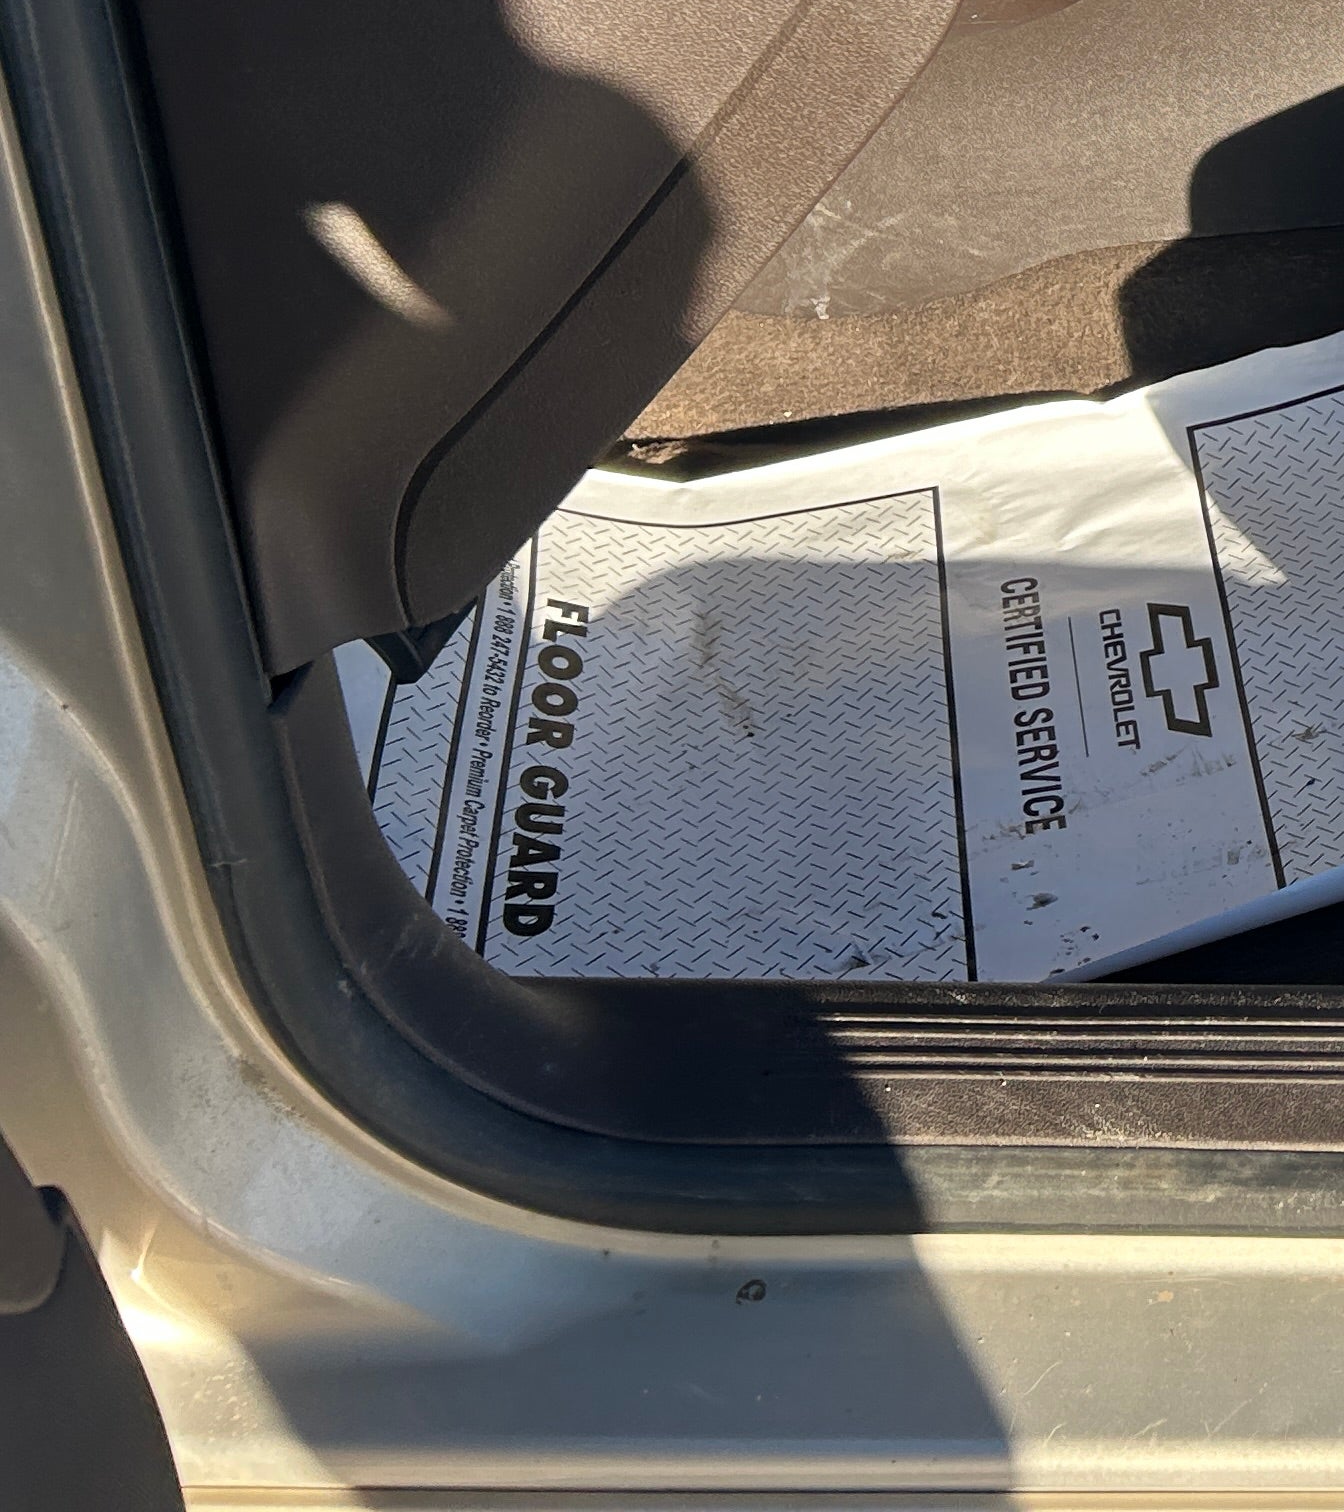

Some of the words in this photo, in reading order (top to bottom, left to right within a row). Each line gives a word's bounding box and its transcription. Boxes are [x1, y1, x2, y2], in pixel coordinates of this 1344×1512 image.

[484, 634, 512, 684] 247-5432
[1000, 576, 1050, 701] CERTIFIED
[482, 683, 502, 696] to
[526, 598, 589, 749] FLOOR
[1098, 607, 1141, 750] CHEVROLET
[474, 696, 501, 742] Reorder
[465, 748, 493, 797] Premium
[1013, 707, 1067, 835] SERVICE
[456, 799, 485, 838] Carpet
[449, 837, 479, 897] Protection
[503, 765, 569, 937] GUARD
